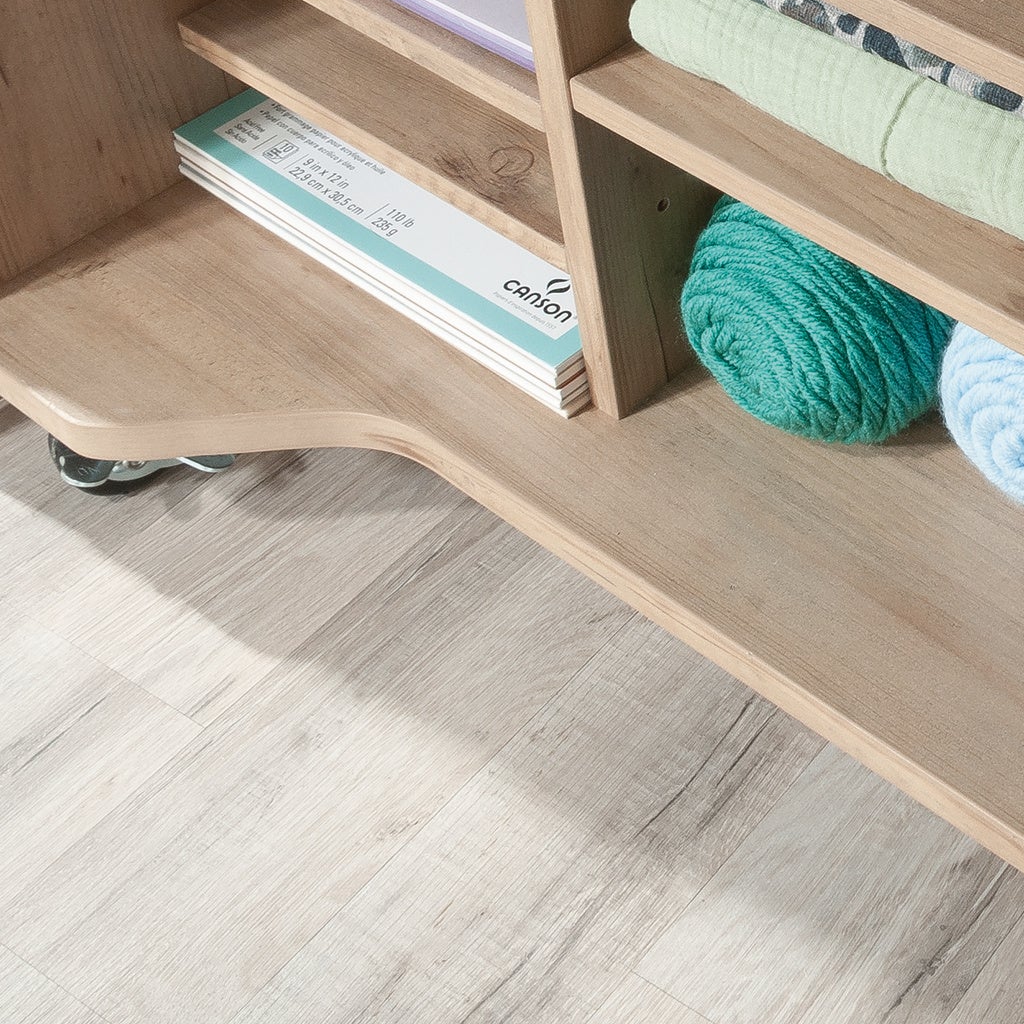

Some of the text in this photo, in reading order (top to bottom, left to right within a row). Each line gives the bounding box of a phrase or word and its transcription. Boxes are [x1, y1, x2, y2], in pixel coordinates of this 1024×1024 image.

[279, 142, 294, 153] 10
[302, 158, 315, 166] 9
[309, 161, 322, 172] in
[327, 172, 342, 184] 12
[337, 179, 350, 190] in
[288, 166, 312, 182] 22,9
[307, 179, 325, 192] cm
[328, 190, 352, 206] 30,5
[346, 205, 365, 216] cm
[371, 216, 399, 238] 235 g
[386, 208, 416, 229] 110 lb
[503, 280, 573, 323] CANSON
